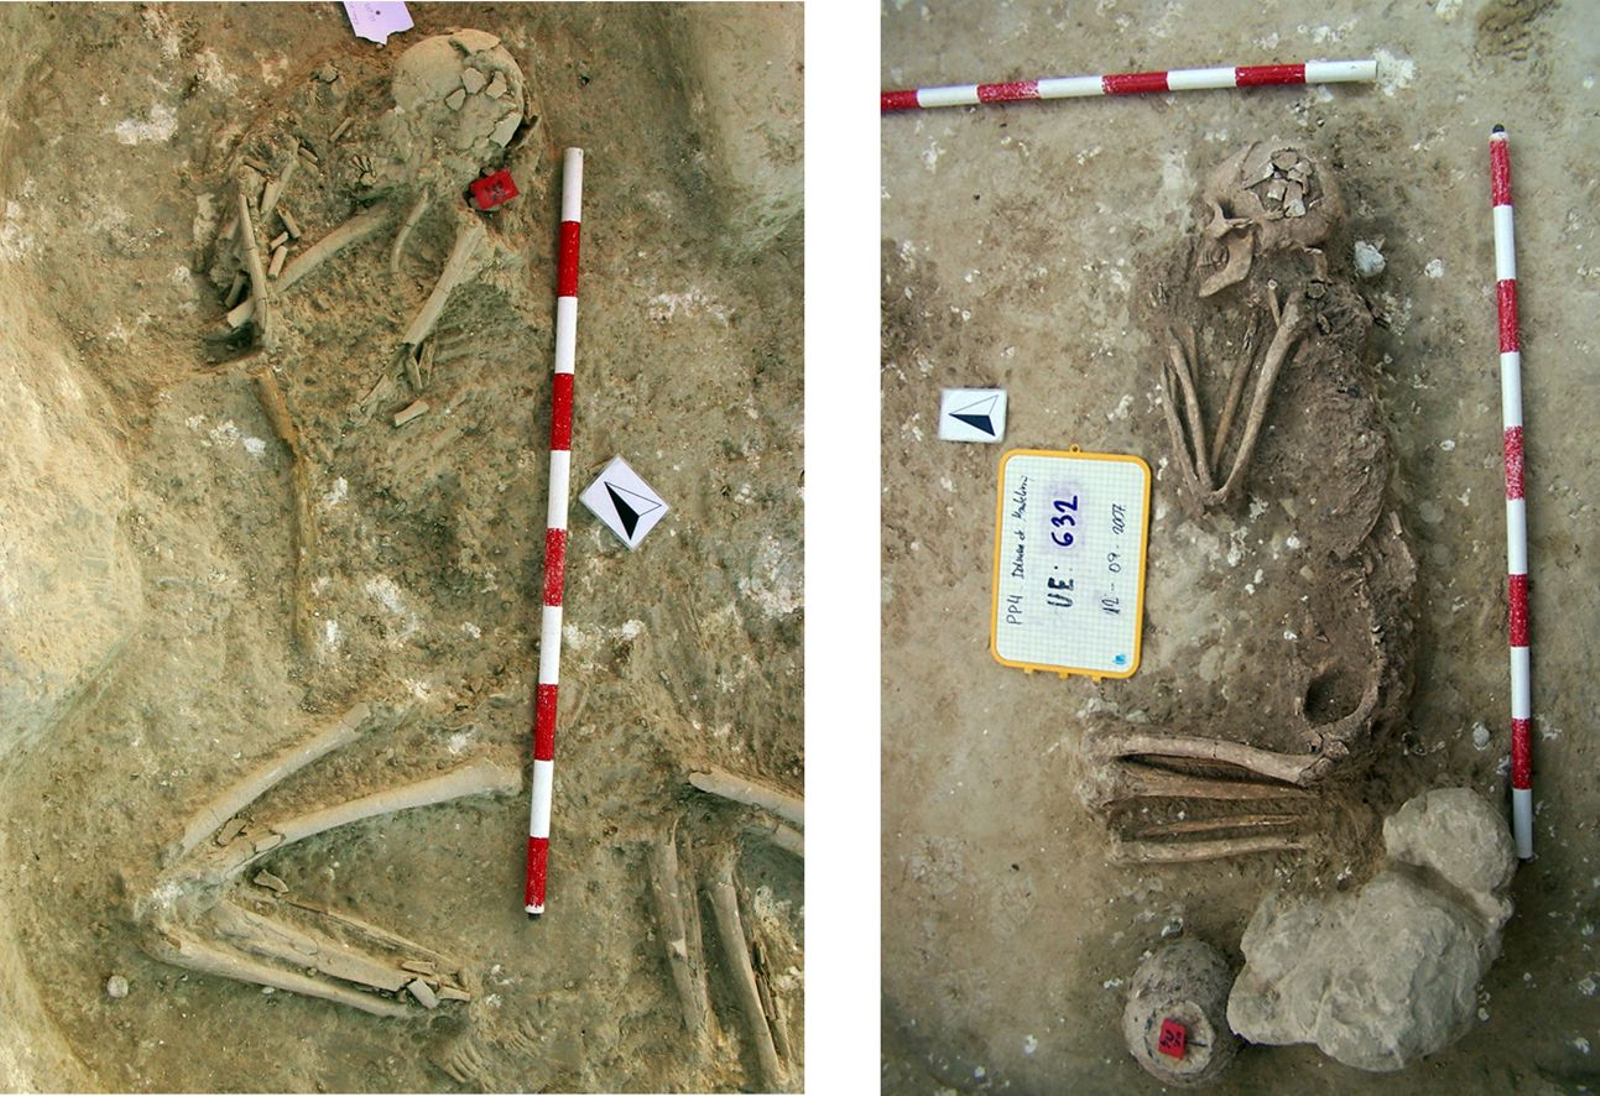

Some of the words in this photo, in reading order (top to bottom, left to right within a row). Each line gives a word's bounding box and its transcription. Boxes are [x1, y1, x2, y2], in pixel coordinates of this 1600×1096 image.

[1051, 495, 1079, 547] 632
[1047, 566, 1075, 608] UE:
[1006, 594, 1023, 625] PP4
